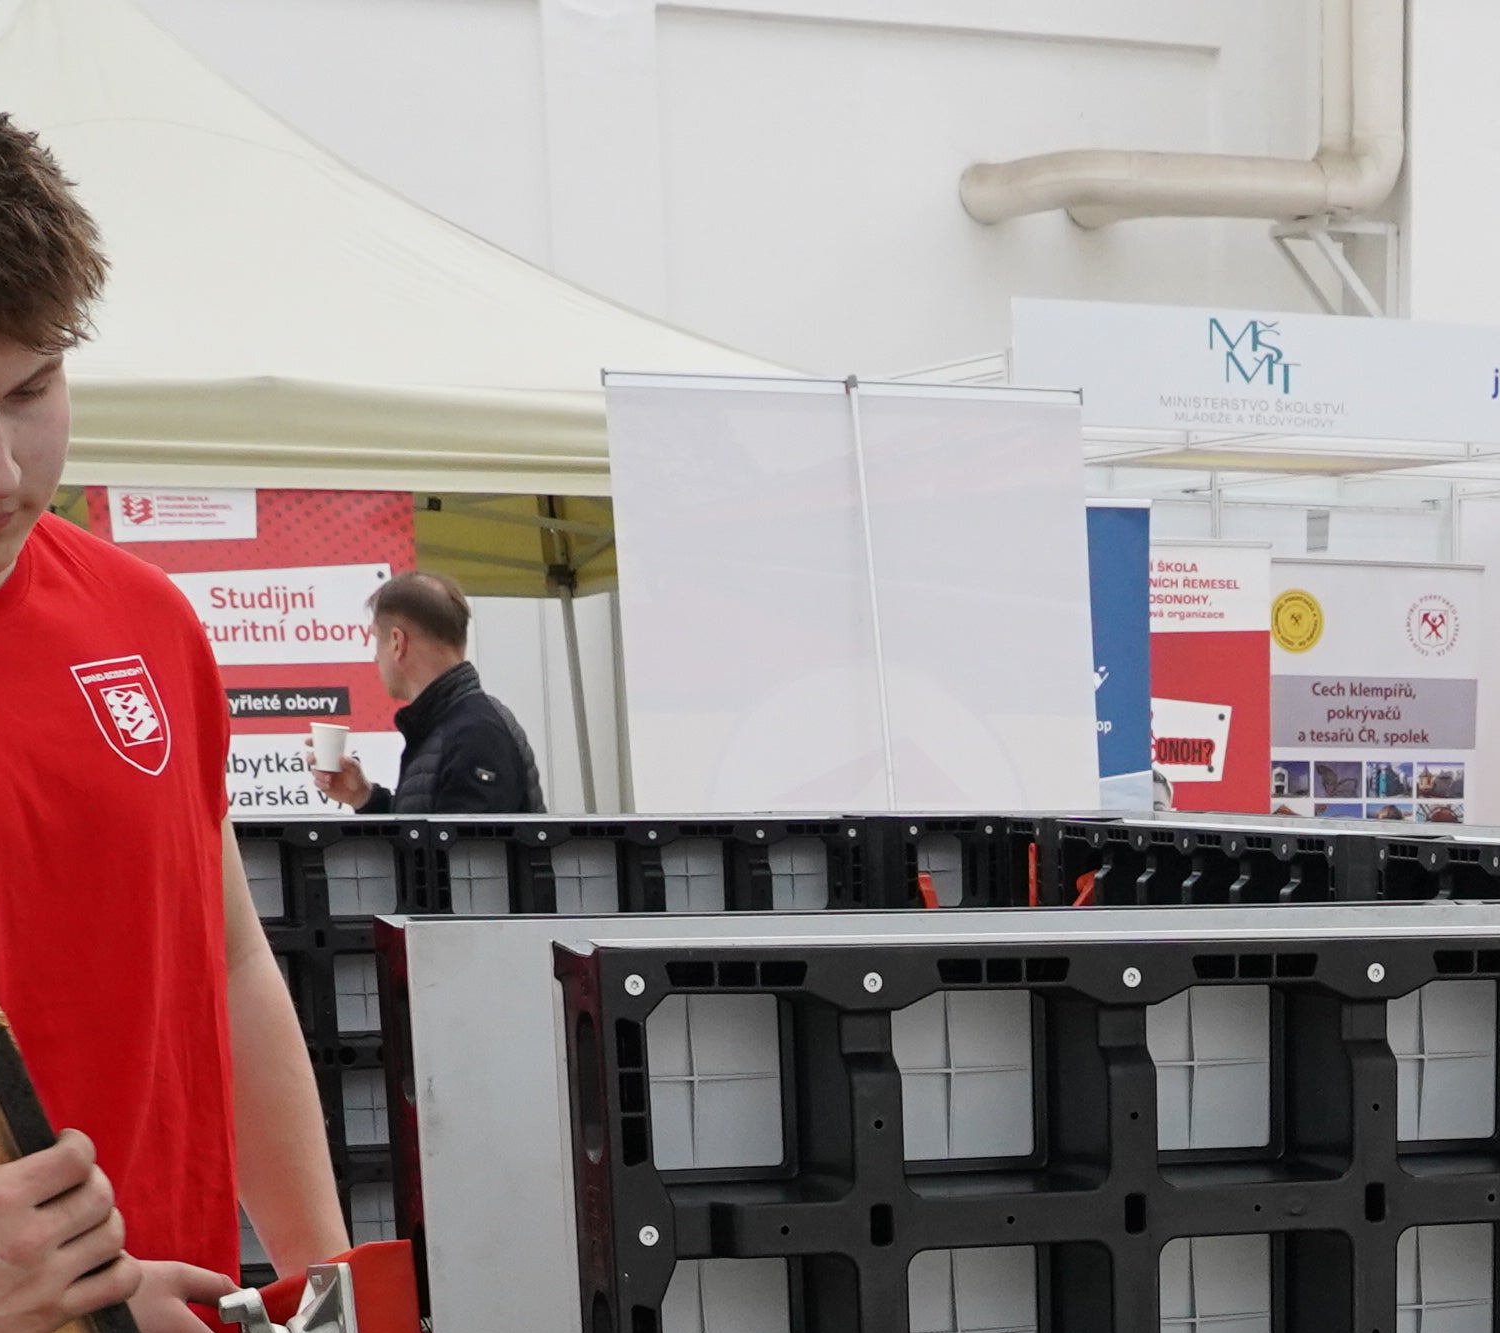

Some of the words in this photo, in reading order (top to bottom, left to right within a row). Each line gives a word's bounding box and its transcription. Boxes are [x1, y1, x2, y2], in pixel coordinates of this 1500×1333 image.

[1158, 394, 1270, 412] MINISTERSTVO
[1274, 398, 1349, 417] ŠKOLSTVÍ,
[1174, 411, 1237, 424] MLÁDEŽE
[1238, 414, 1245, 423] A
[1157, 560, 1199, 573] ŠKOLA
[1149, 576, 1179, 589] NÍCH
[1182, 577, 1241, 590] ŘEMESEL
[209, 585, 316, 615] Studijní
[1167, 609, 1225, 621] organizace
[201, 619, 286, 642] turitní
[294, 618, 372, 647] obory
[1311, 682, 1346, 697] Cech
[1350, 682, 1417, 701] klempířů,
[228, 694, 281, 715] yřleté
[284, 693, 339, 713] obory
[1327, 706, 1401, 723] pokrývačů
[1298, 730, 1307, 742] a
[1310, 727, 1354, 743] tesařů
[1358, 726, 1380, 744] ČR,
[1383, 729, 1430, 746] spolek
[1157, 739, 1215, 763] ONOH?
[228, 785, 309, 807] vařská
